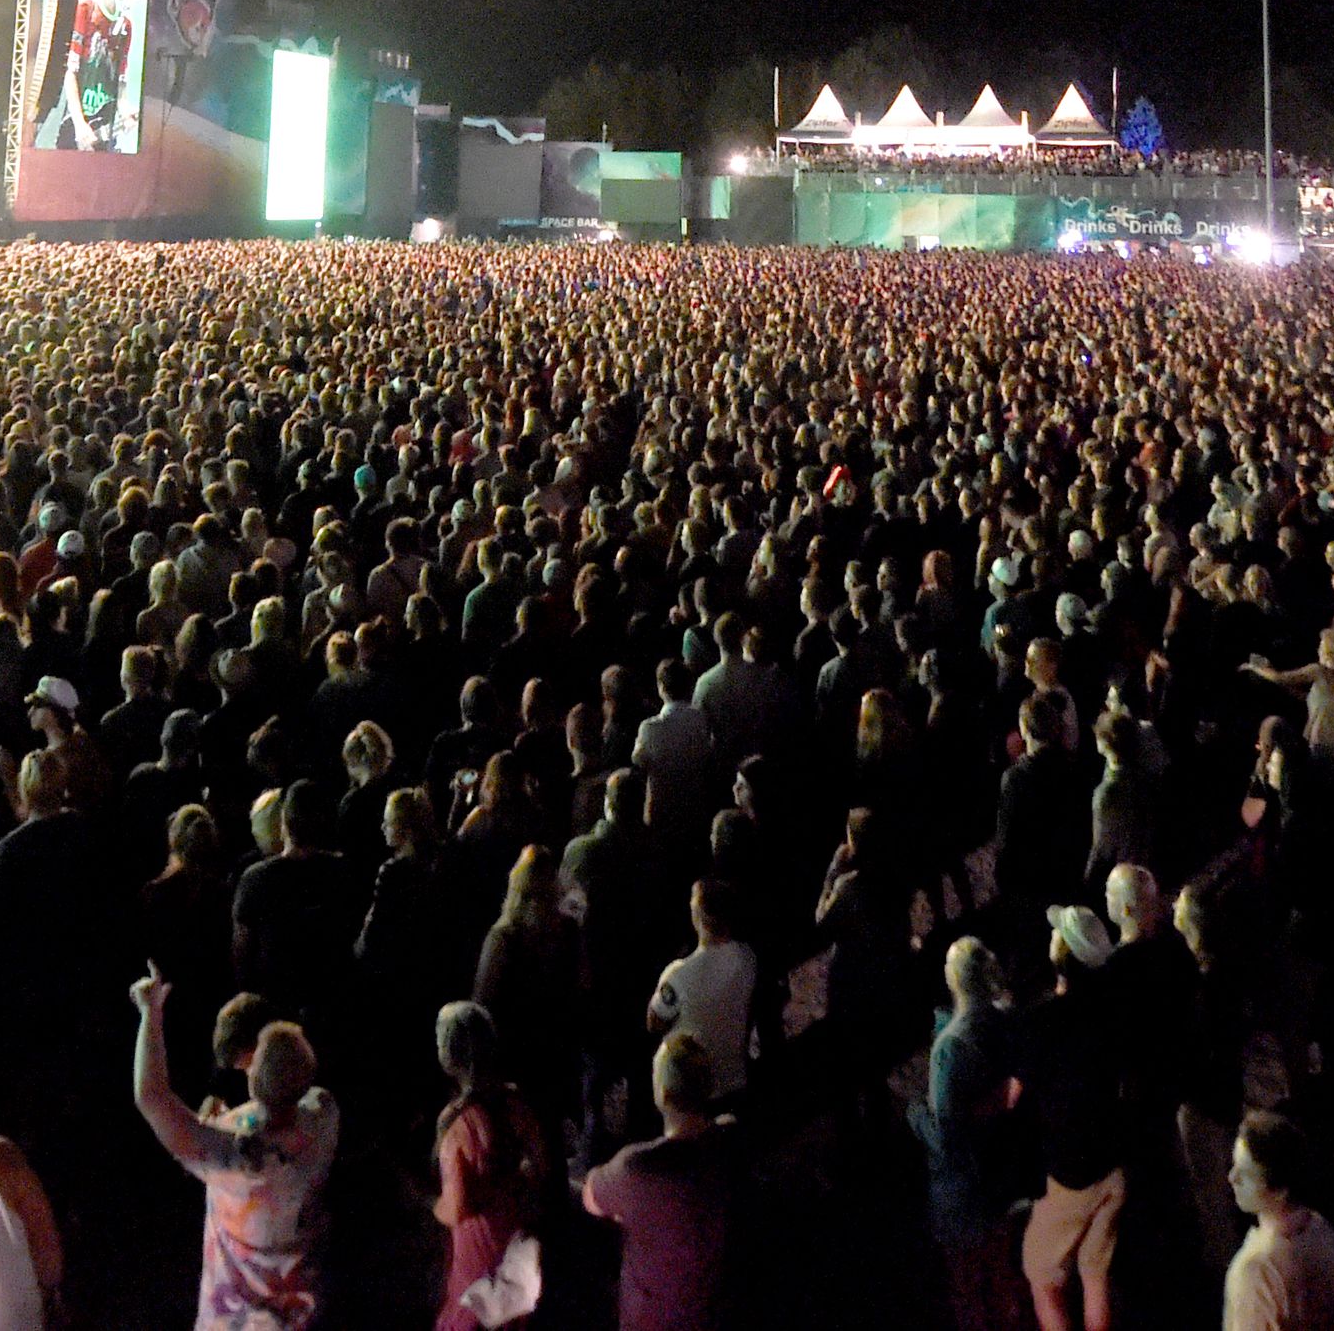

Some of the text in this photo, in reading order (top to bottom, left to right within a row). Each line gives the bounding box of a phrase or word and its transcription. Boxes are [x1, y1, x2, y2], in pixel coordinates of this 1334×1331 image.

[541, 217, 575, 228] SPACE
[577, 217, 599, 227] BAR
[1064, 218, 1117, 234] Drinks
[1129, 220, 1183, 235] Drinks
[1196, 221, 1252, 236] Drinks
